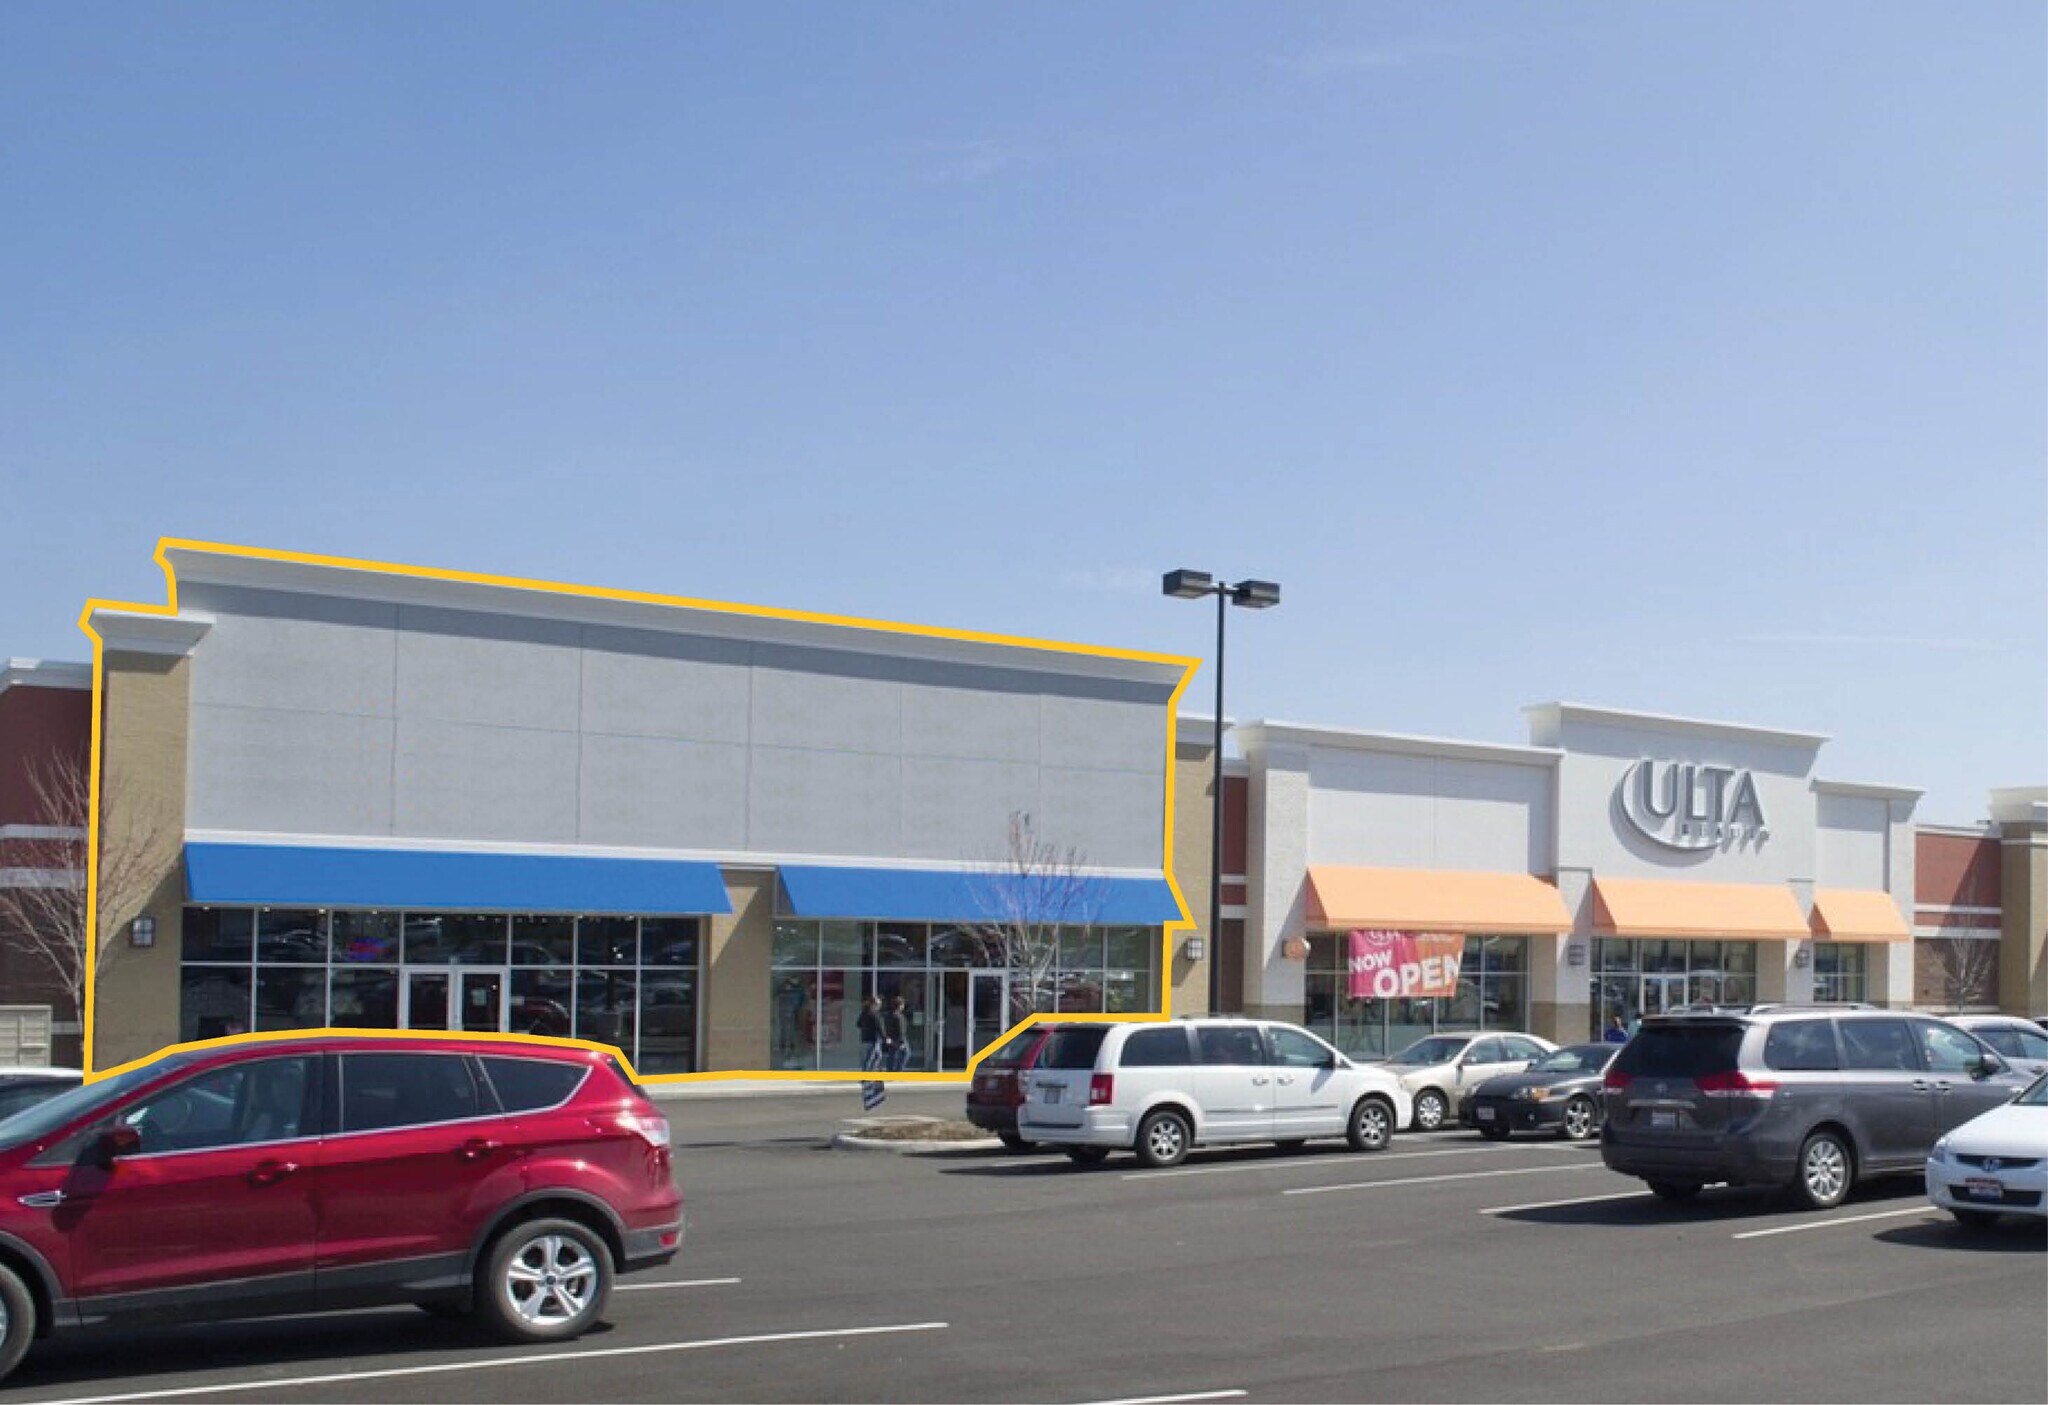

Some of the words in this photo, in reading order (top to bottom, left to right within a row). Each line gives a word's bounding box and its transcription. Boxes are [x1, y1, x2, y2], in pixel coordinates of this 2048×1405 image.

[1641, 760, 1765, 825] ULTA
[1349, 949, 1393, 973] NOW
[1373, 950, 1463, 998] OPEN
